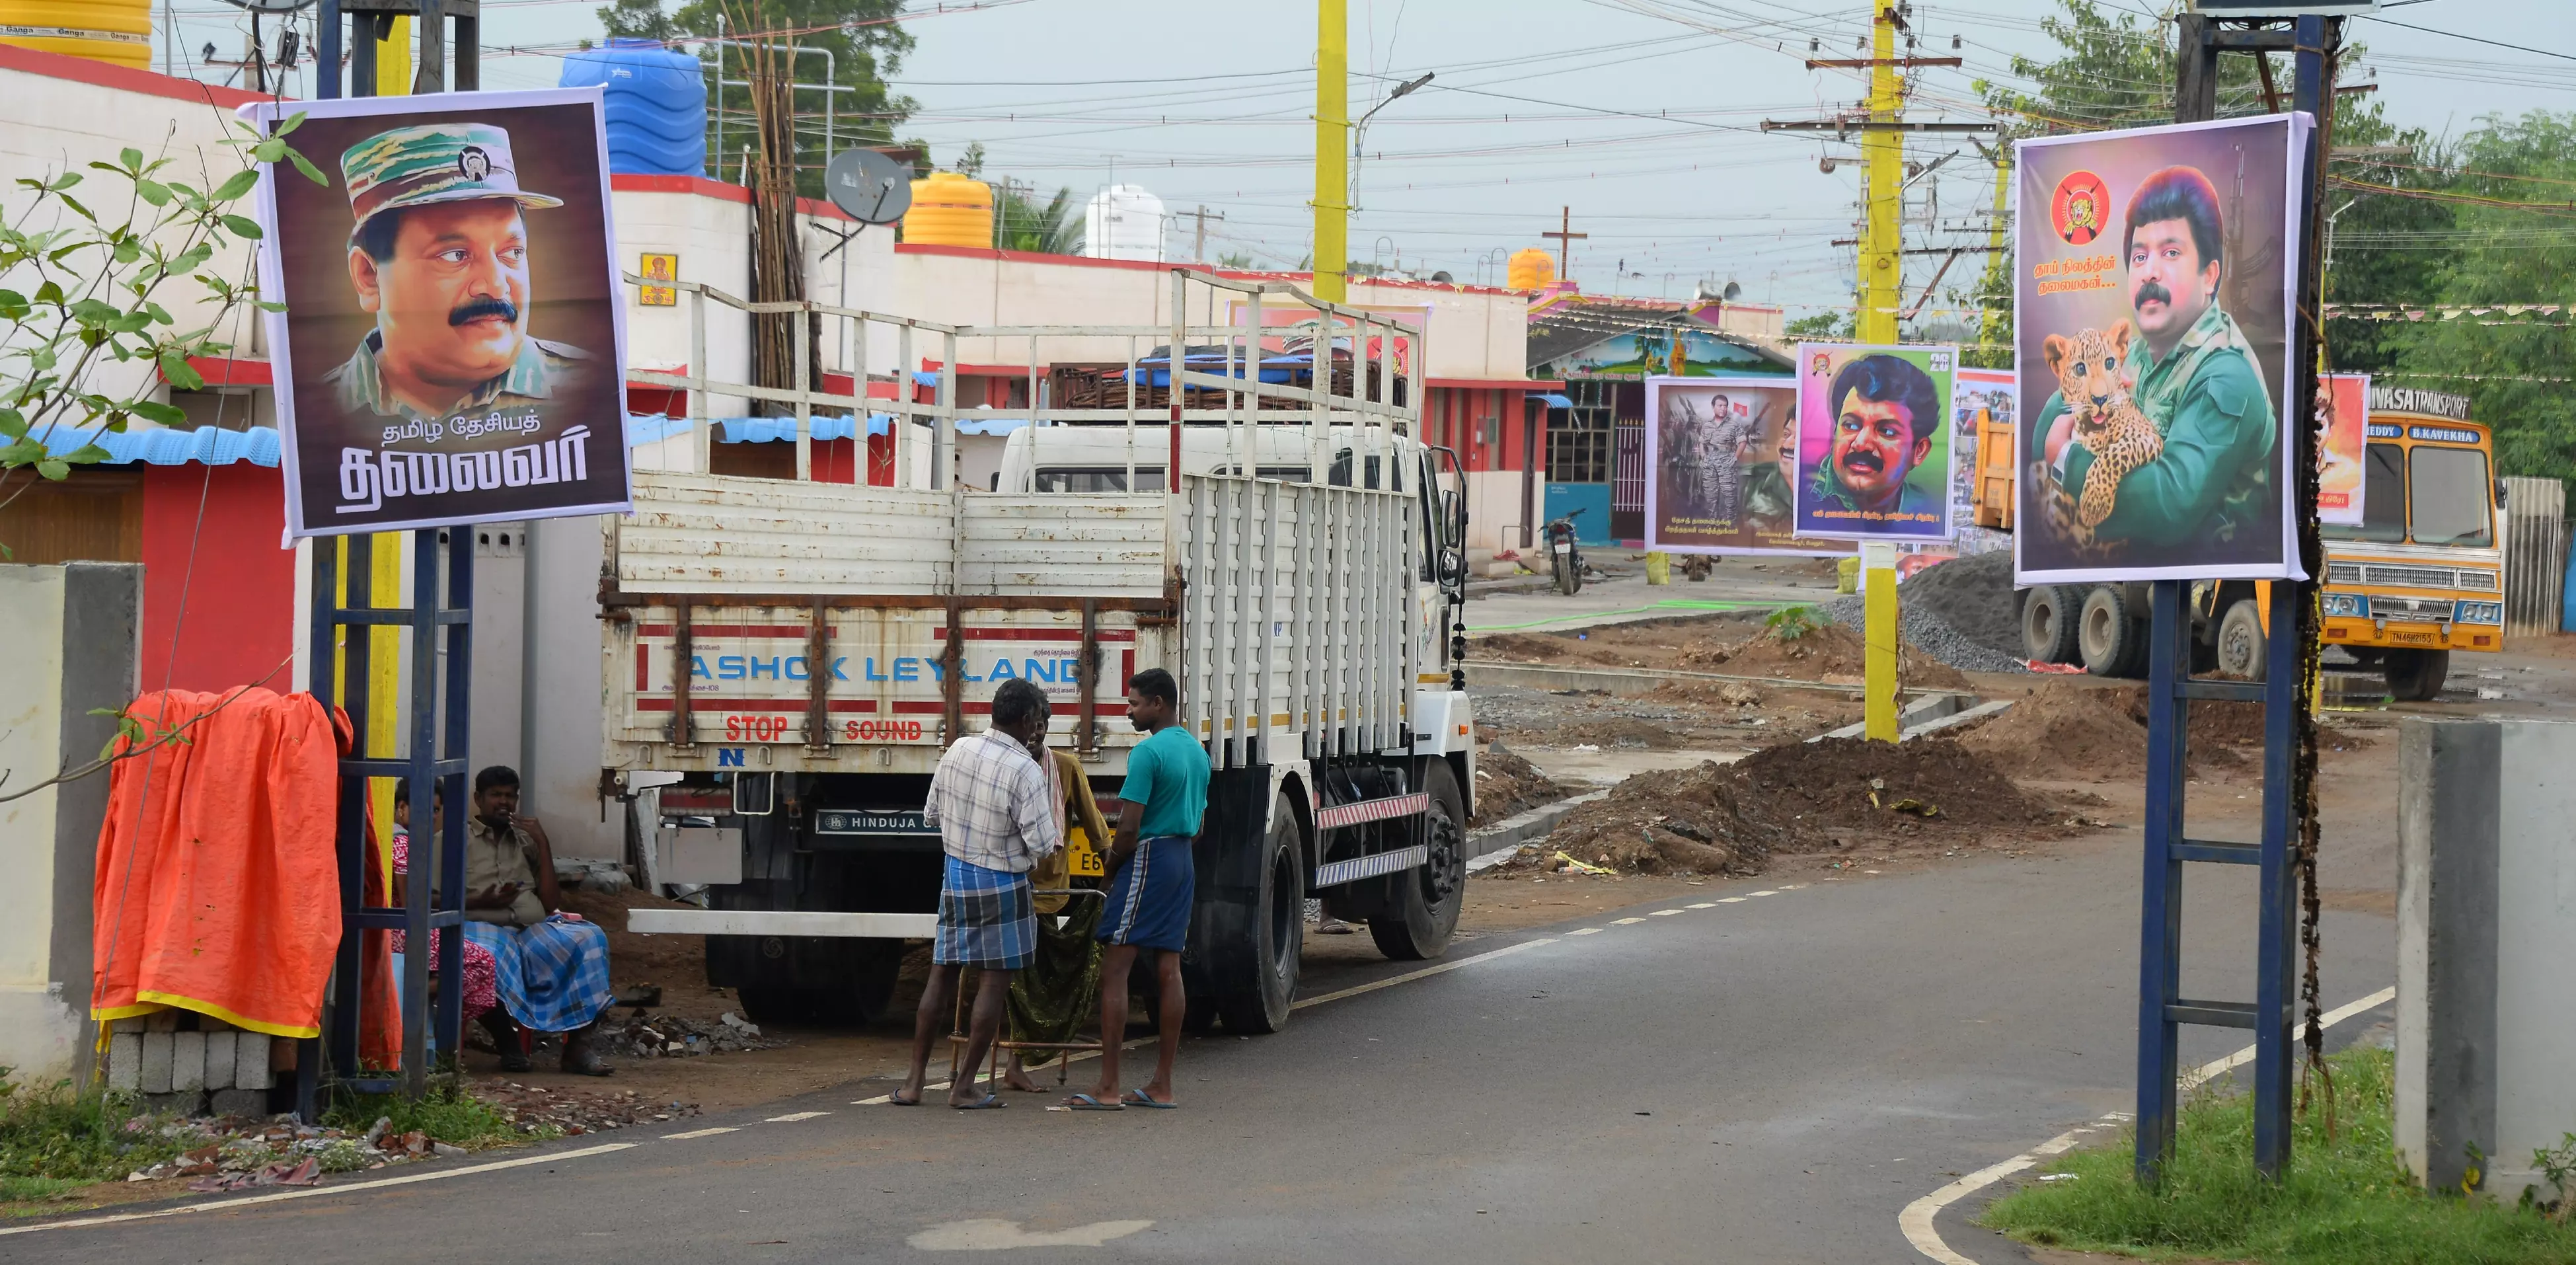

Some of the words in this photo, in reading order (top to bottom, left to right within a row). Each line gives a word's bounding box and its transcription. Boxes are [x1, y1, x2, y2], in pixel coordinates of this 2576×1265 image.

[58, 28, 85, 37] Ganga
[2034, 259, 2059, 279] தாய்
[2061, 254, 2115, 276] நிலத்தின்
[2368, 386, 2414, 410] IVASA
[2414, 391, 2470, 420] TRANSPORT
[381, 416, 443, 447] தமிழ்
[449, 408, 541, 441] தேசியத்
[336, 424, 591, 514] தலைவர்
[866, 656, 1080, 683] LEYLAND
[726, 716, 788, 743] STOP
[846, 720, 922, 741] SOUND
[718, 748, 745, 767] N
[852, 818, 916, 828] HINDUJA
